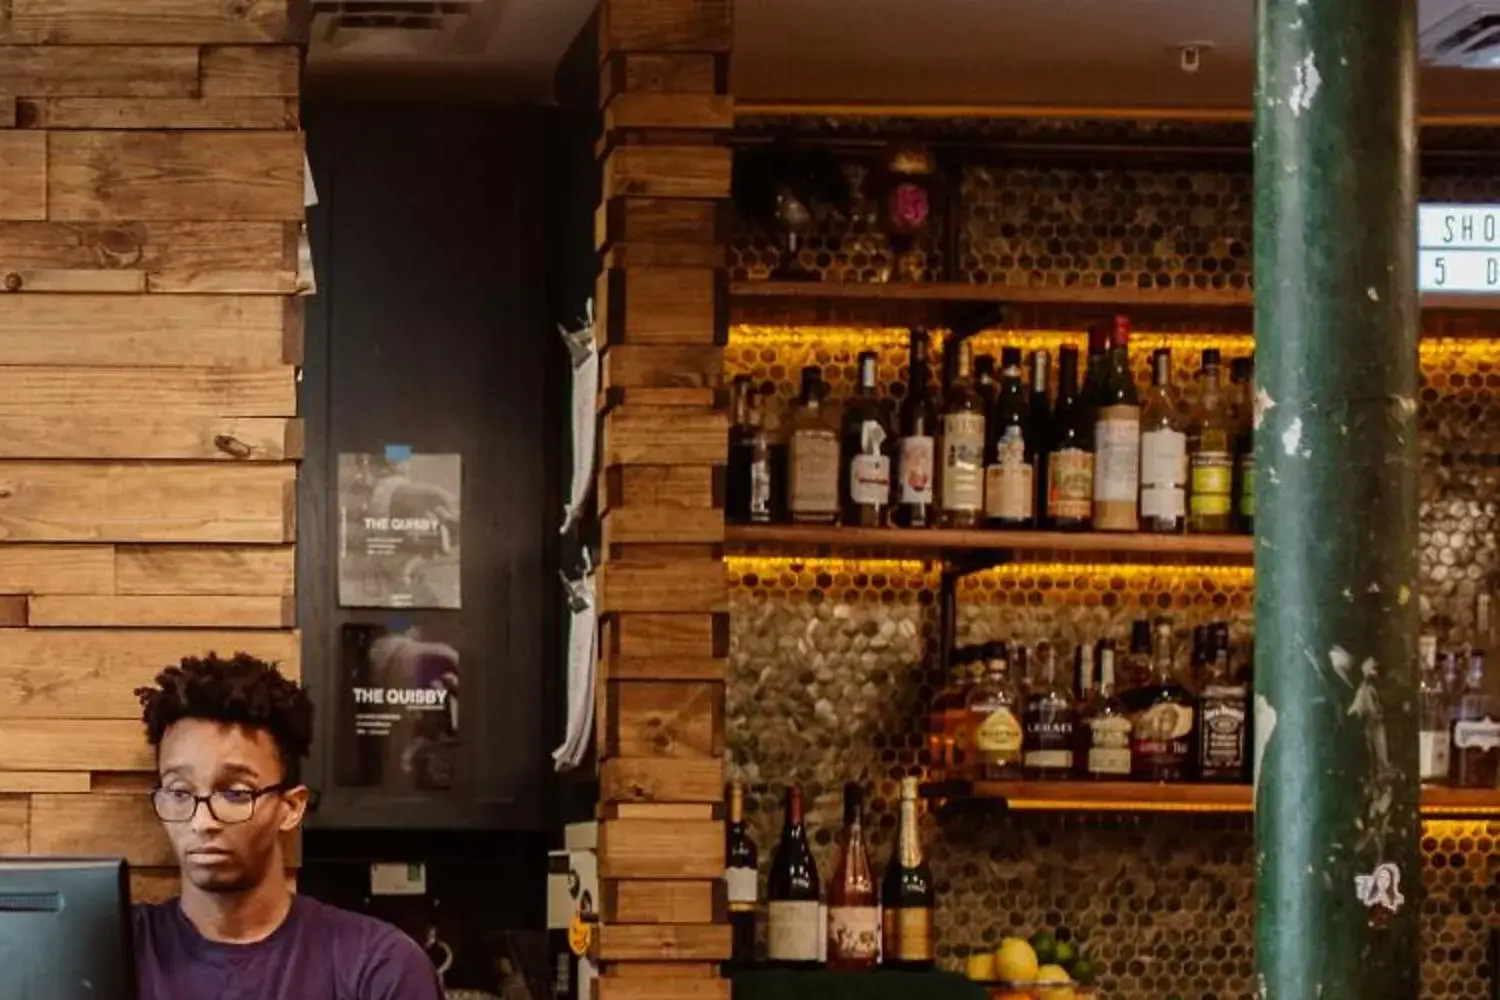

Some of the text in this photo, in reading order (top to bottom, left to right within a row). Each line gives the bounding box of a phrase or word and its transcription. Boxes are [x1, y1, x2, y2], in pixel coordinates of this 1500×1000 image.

[1435, 257, 1445, 285] 5
[364, 517, 388, 530] THE
[352, 687, 448, 705] THE QUISBY
